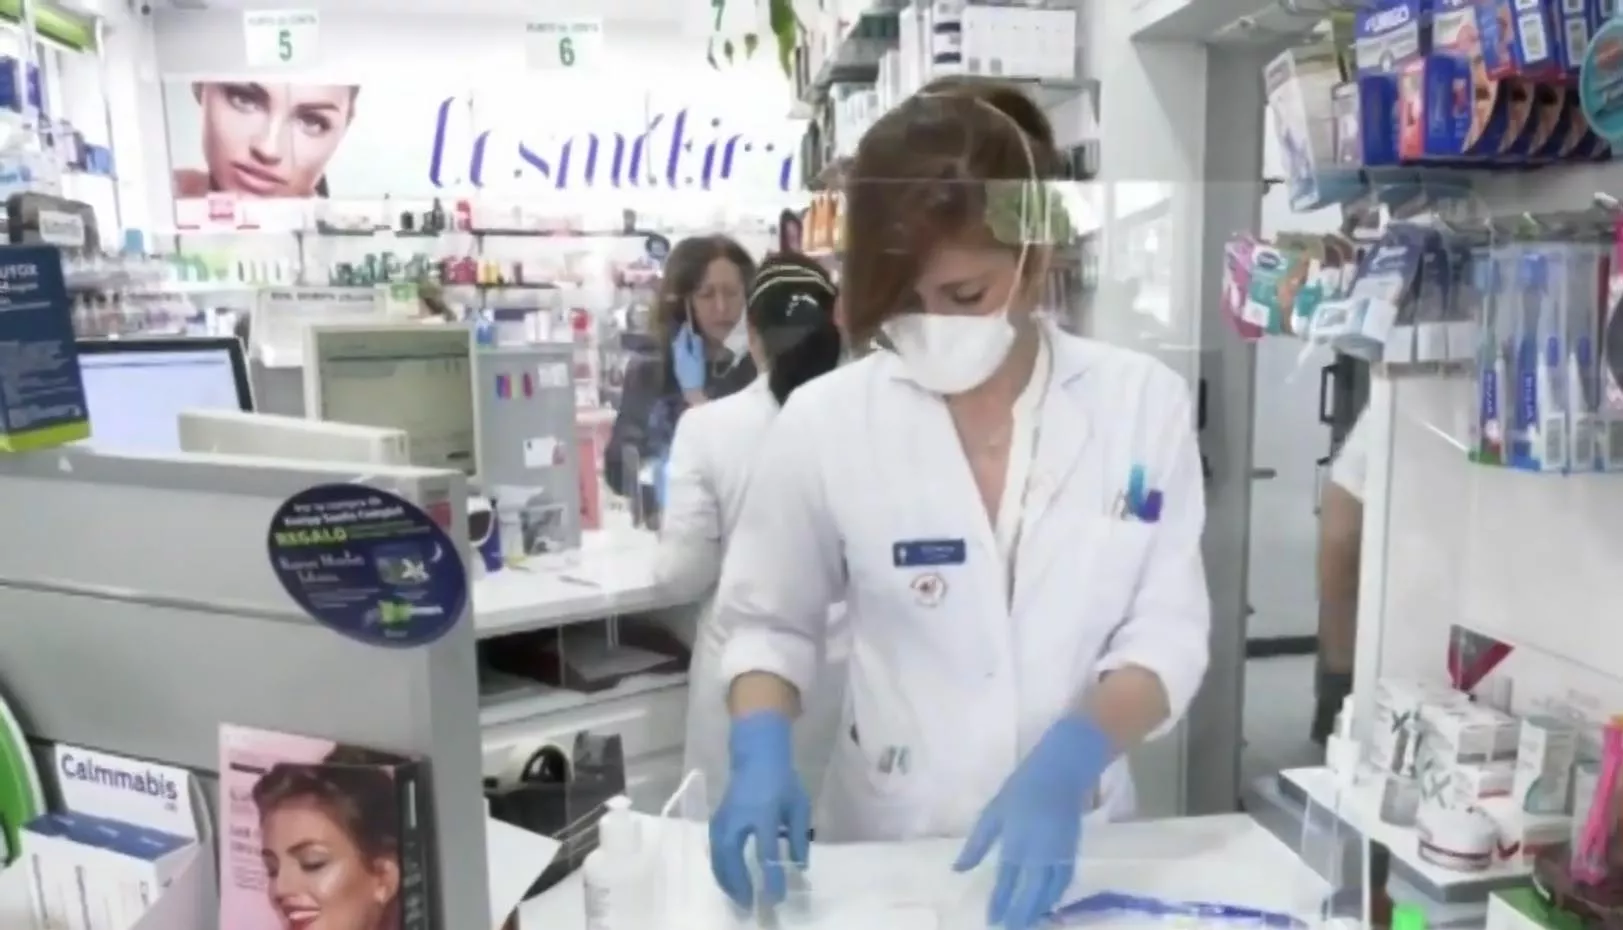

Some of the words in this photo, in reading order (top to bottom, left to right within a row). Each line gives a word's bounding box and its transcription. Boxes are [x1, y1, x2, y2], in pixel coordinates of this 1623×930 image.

[279, 29, 293, 62] 5
[559, 36, 575, 67] 6
[275, 526, 348, 548] REGALO
[60, 752, 179, 801] Calmmabis
